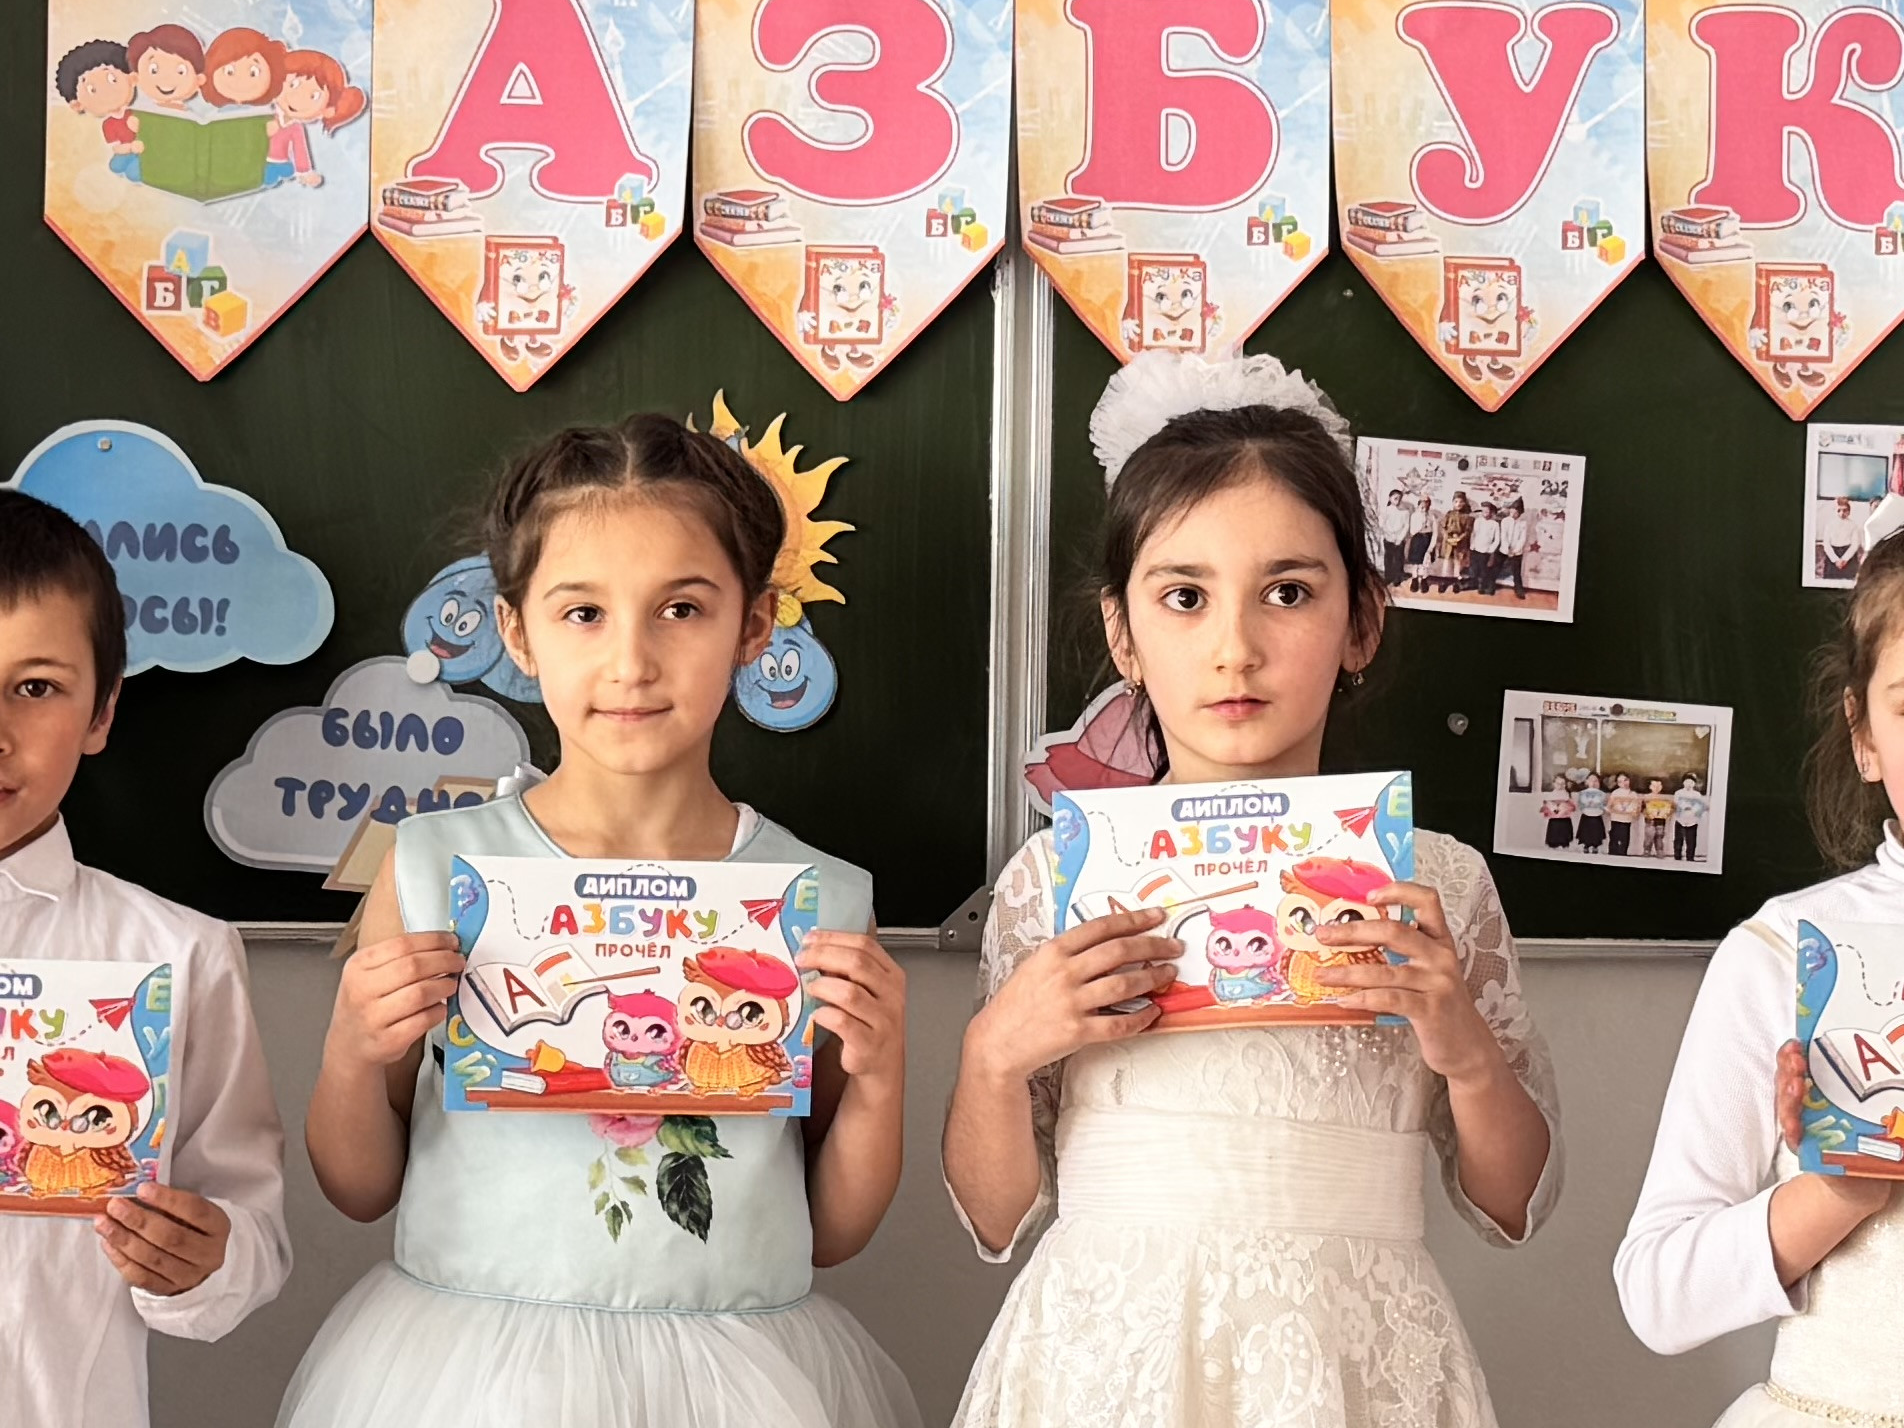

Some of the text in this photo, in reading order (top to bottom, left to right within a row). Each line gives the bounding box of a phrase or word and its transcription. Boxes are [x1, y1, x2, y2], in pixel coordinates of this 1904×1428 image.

[321, 707, 465, 756] БЫЛО
[1179, 794, 1283, 820] ДИПЛОМ
[1149, 821, 1314, 861] АЗБУКУ
[1194, 858, 1268, 878] ПРОЧЁЛ
[582, 876, 689, 900] ДИПЛОМ
[550, 902, 720, 940] АЗБУКУ
[595, 941, 671, 960] ПРОЧЁЛ
